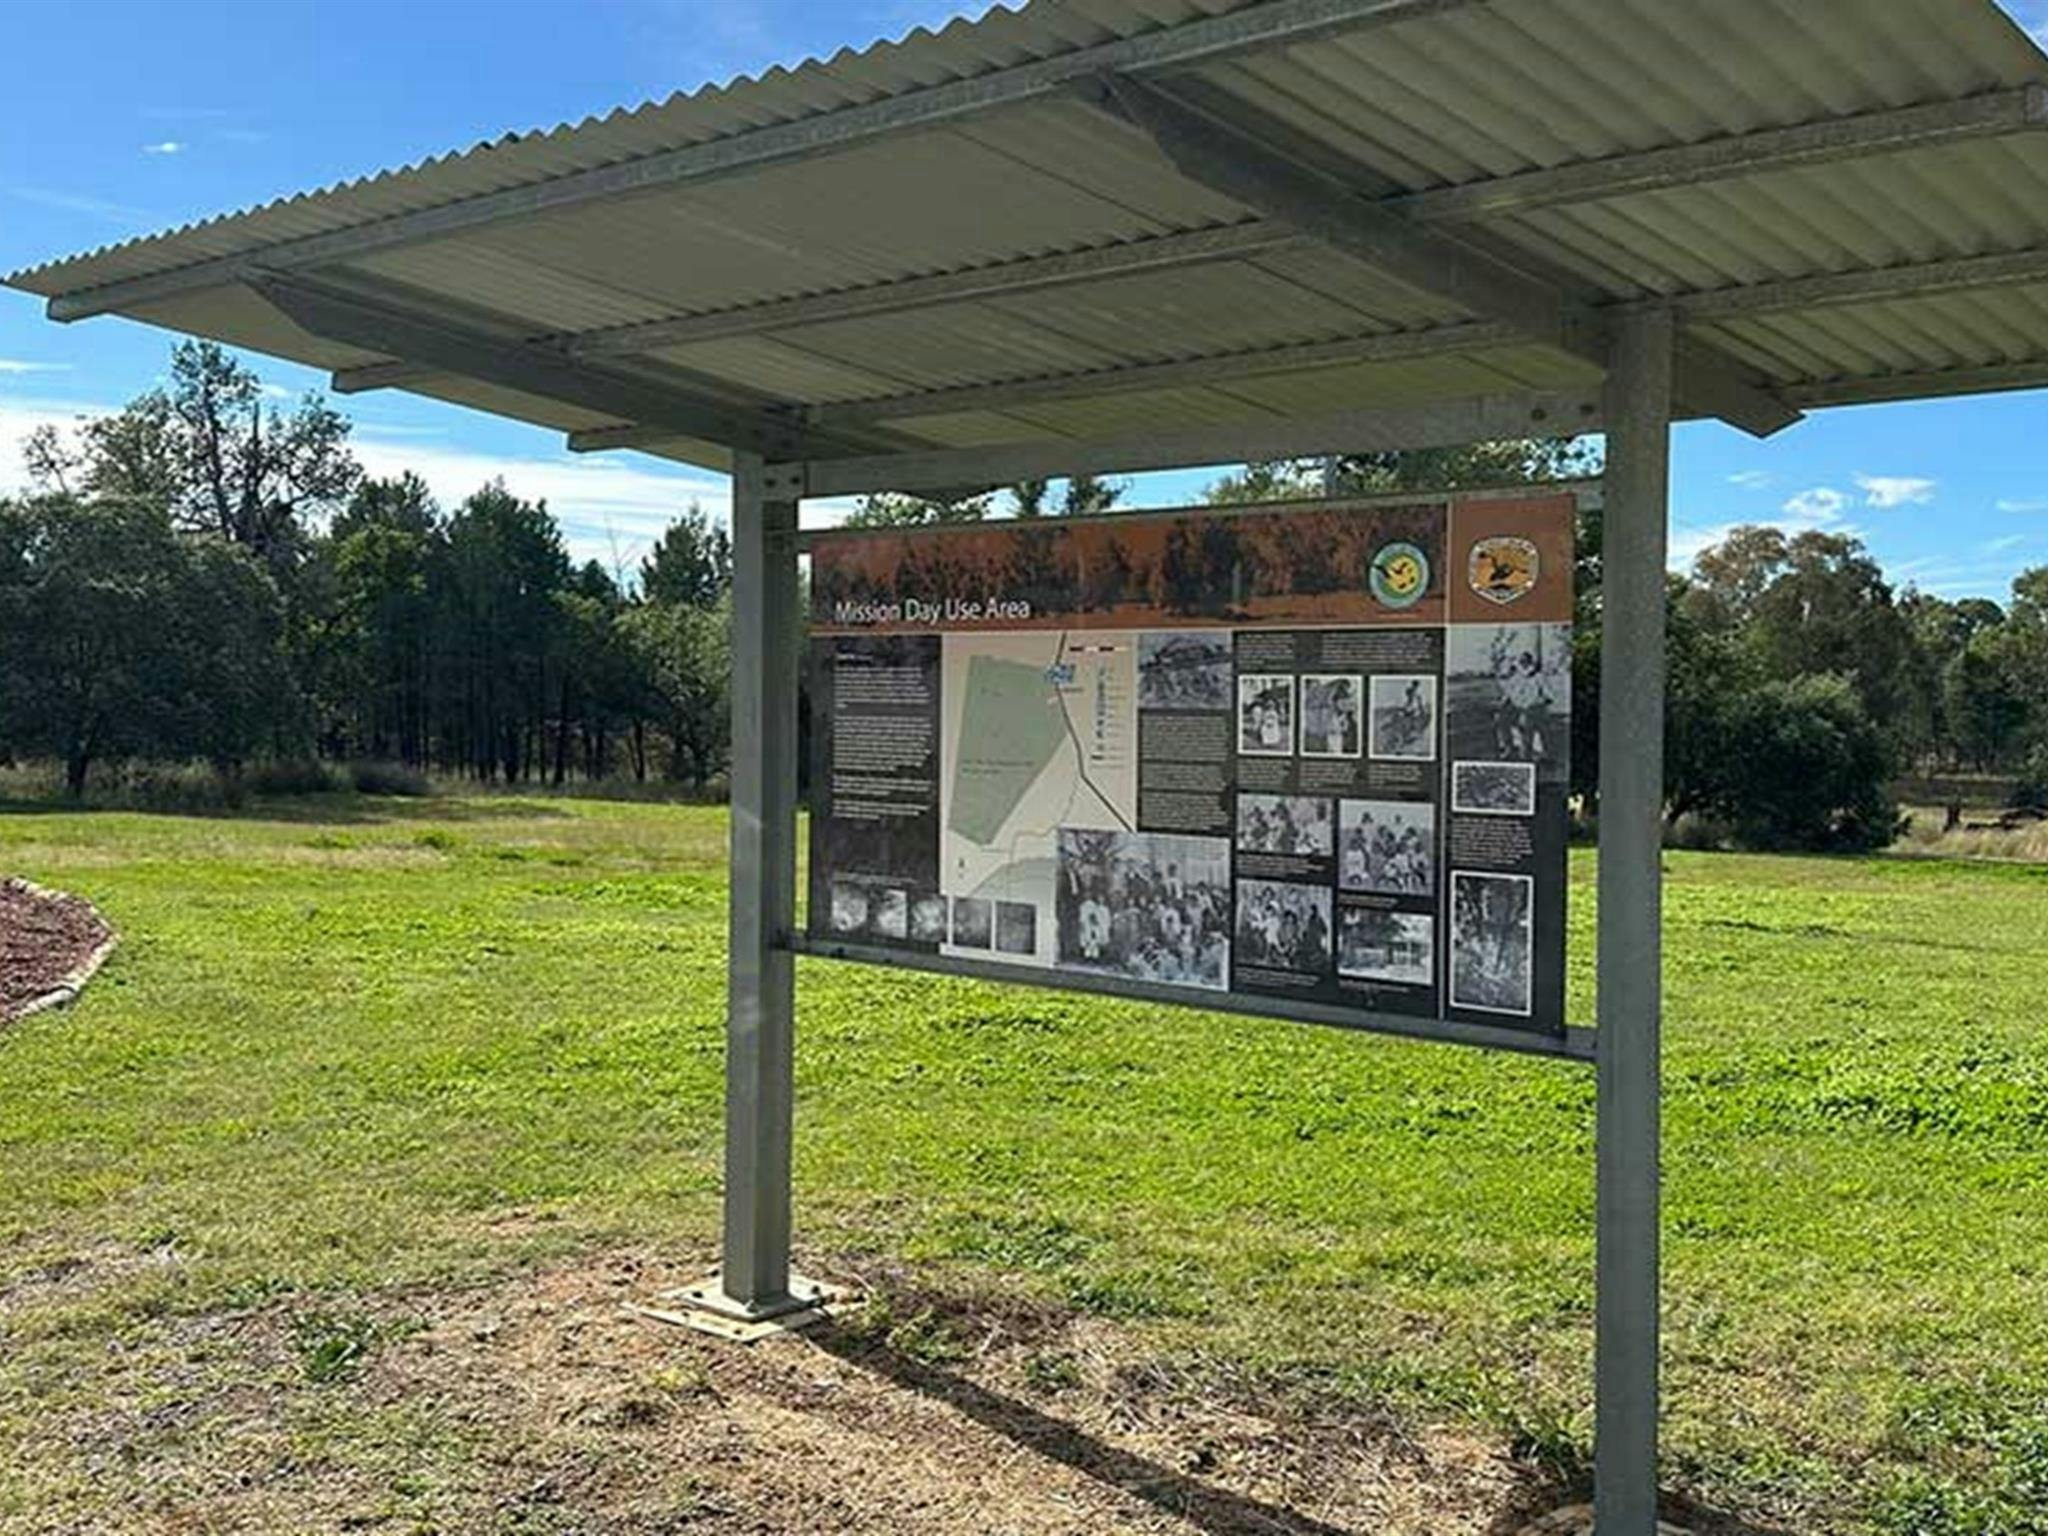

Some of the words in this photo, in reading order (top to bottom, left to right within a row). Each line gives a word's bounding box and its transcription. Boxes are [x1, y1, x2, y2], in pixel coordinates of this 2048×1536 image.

[835, 601, 900, 623] Mission
[904, 599, 942, 625] Day
[945, 599, 981, 620] Use
[985, 598, 1031, 620] Area
